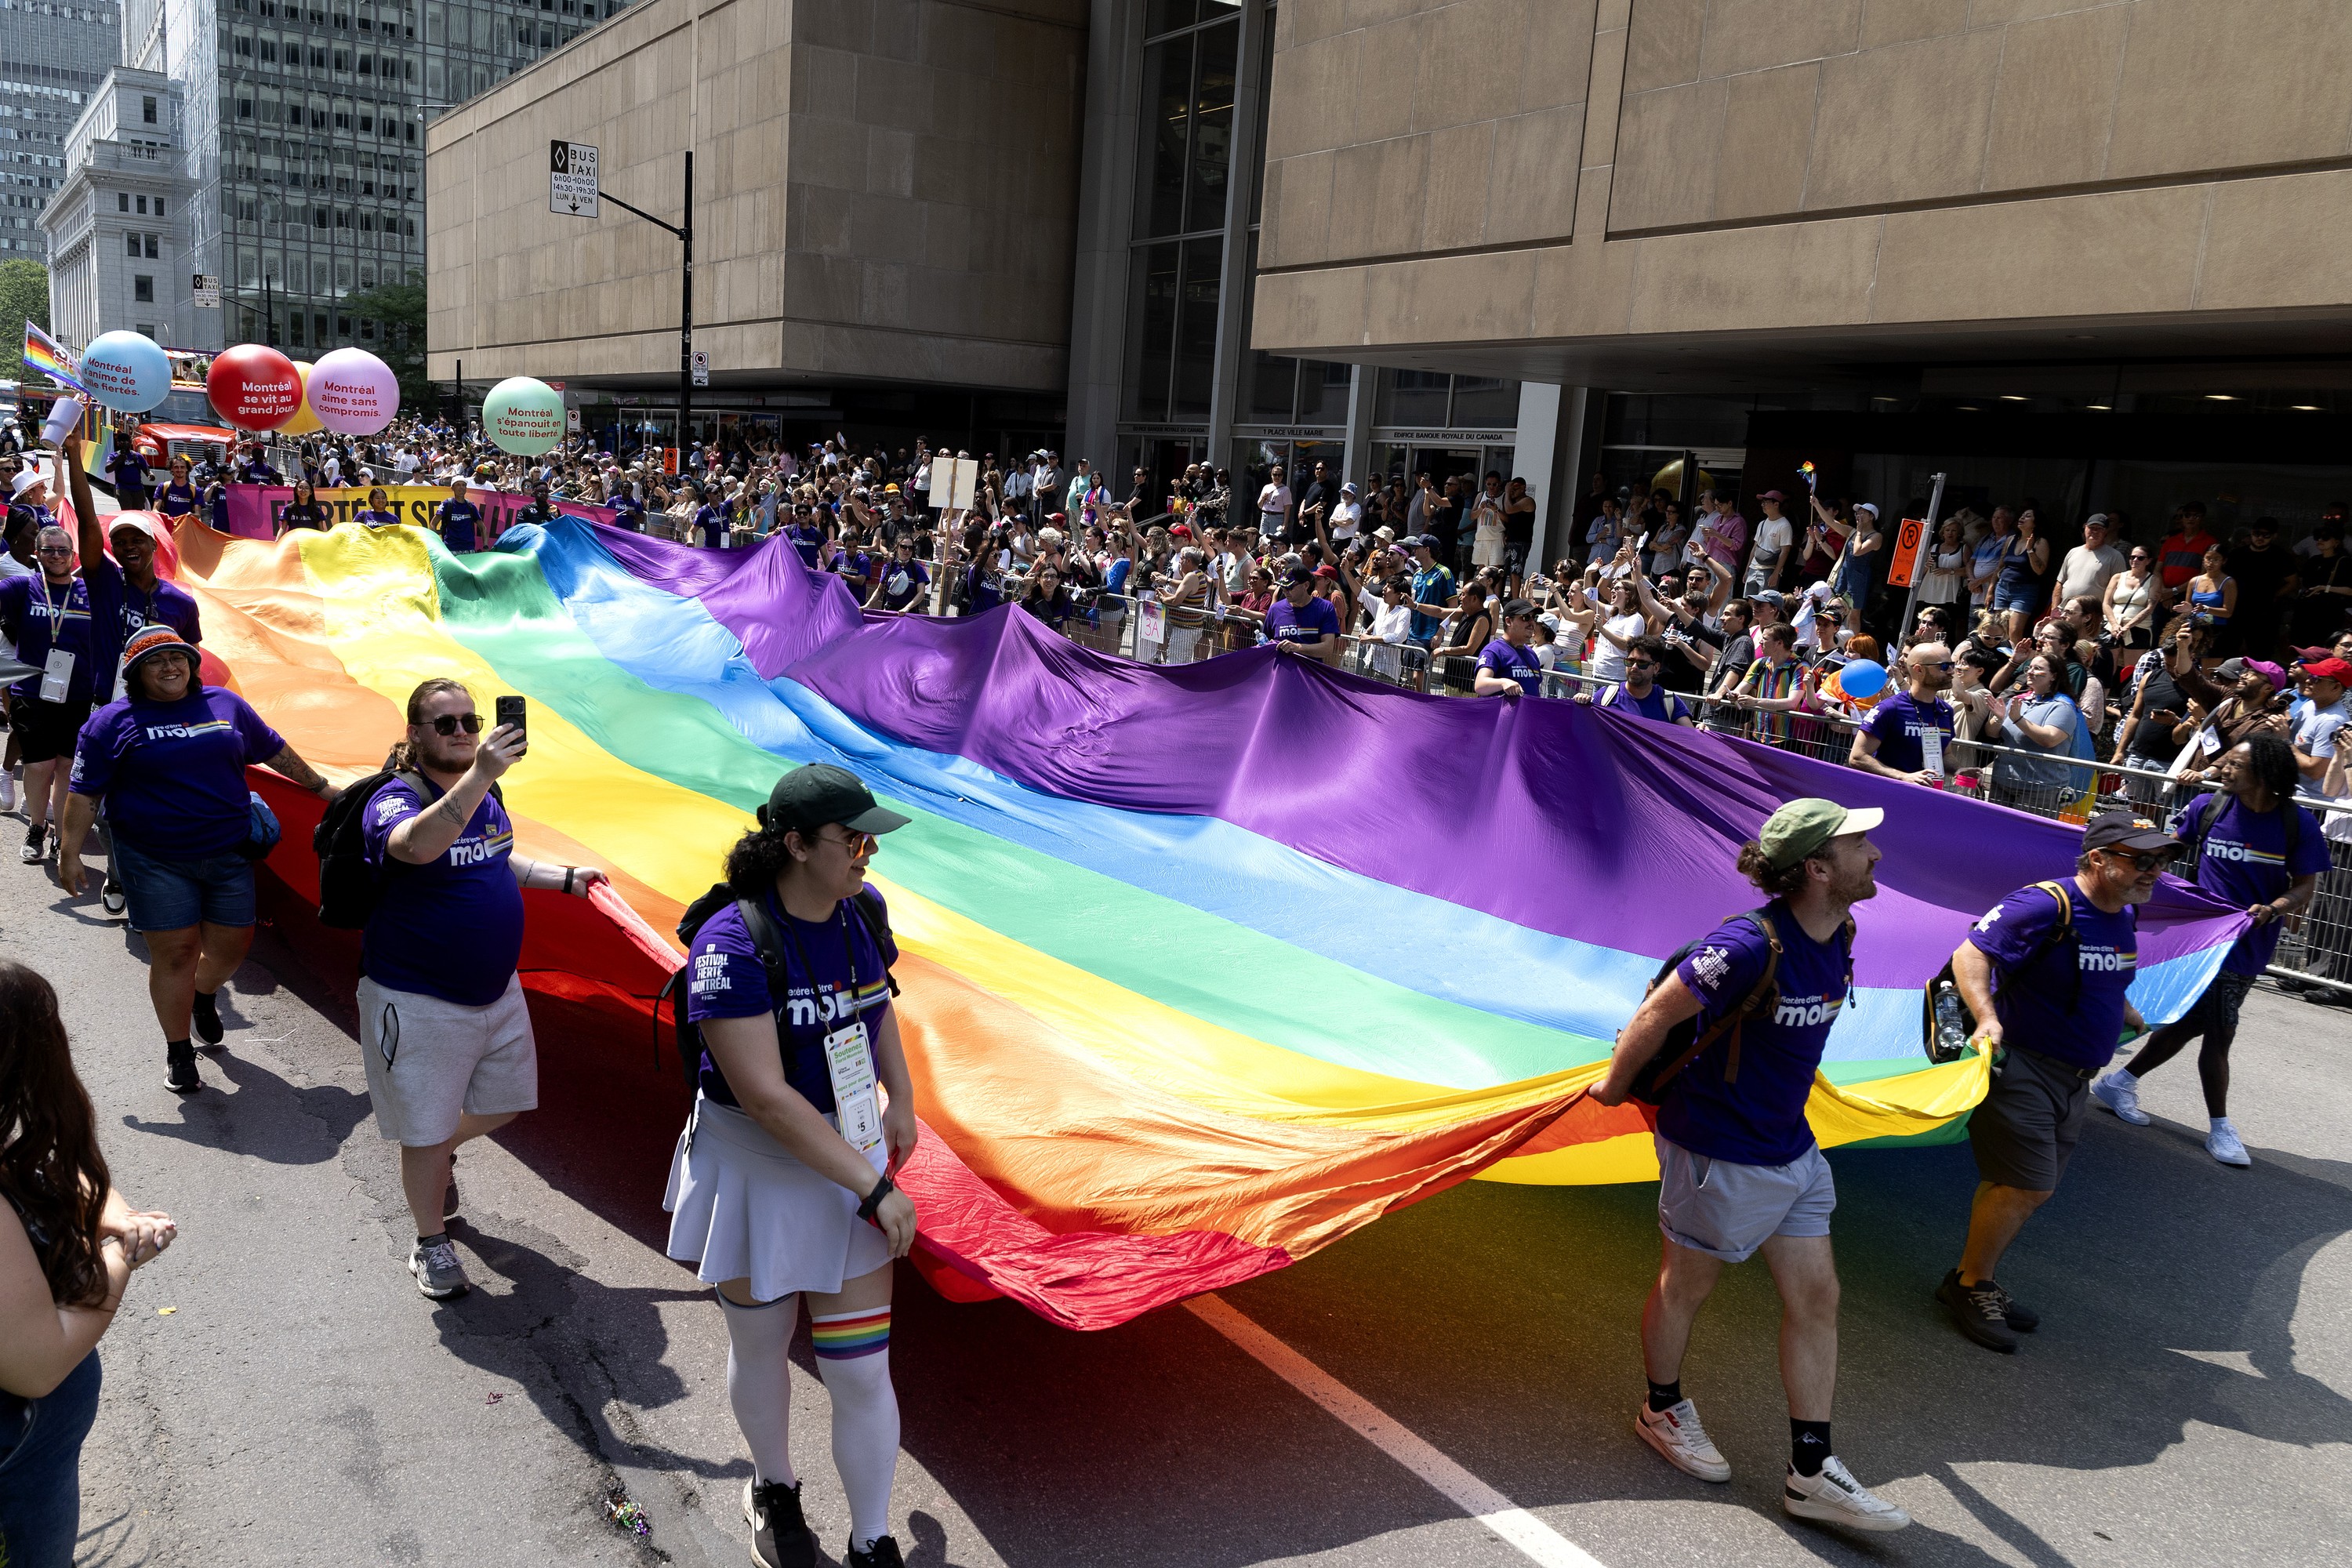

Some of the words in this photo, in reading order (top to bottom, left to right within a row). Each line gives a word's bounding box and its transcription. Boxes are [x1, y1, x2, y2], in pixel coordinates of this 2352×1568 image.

[571, 149, 596, 163] BUS
[571, 164, 596, 177] TAXI
[554, 174, 595, 187] 6h00-10h00
[554, 183, 596, 196] 14h30-19h30
[88, 357, 132, 375] Montréal
[84, 367, 118, 383] s'anime
[121, 376, 136, 386] de
[101, 383, 140, 396] fiertés.
[241, 381, 292, 392] Montréal
[325, 381, 375, 395] Montréal
[261, 394, 278, 404] vit
[321, 394, 348, 405] aime
[238, 405, 273, 415] grand
[274, 405, 295, 416] jour.
[318, 405, 381, 417] compromis.
[508, 407, 554, 417] Montréal
[497, 417, 550, 428] s'épanouit
[499, 428, 525, 437] toute
[1145, 618, 1160, 639] 3A
[695, 953, 729, 969] FESTIVAL
[697, 965, 723, 980] FIERTÉ
[1691, 956, 1720, 991] MONTRÉAL
[691, 977, 732, 994] MONTRÉAL
[834, 1043, 862, 1059] Soutenez
[848, 1079, 858, 1088] pour
[858, 1074, 871, 1083] donner
[858, 1121, 866, 1132] $5
